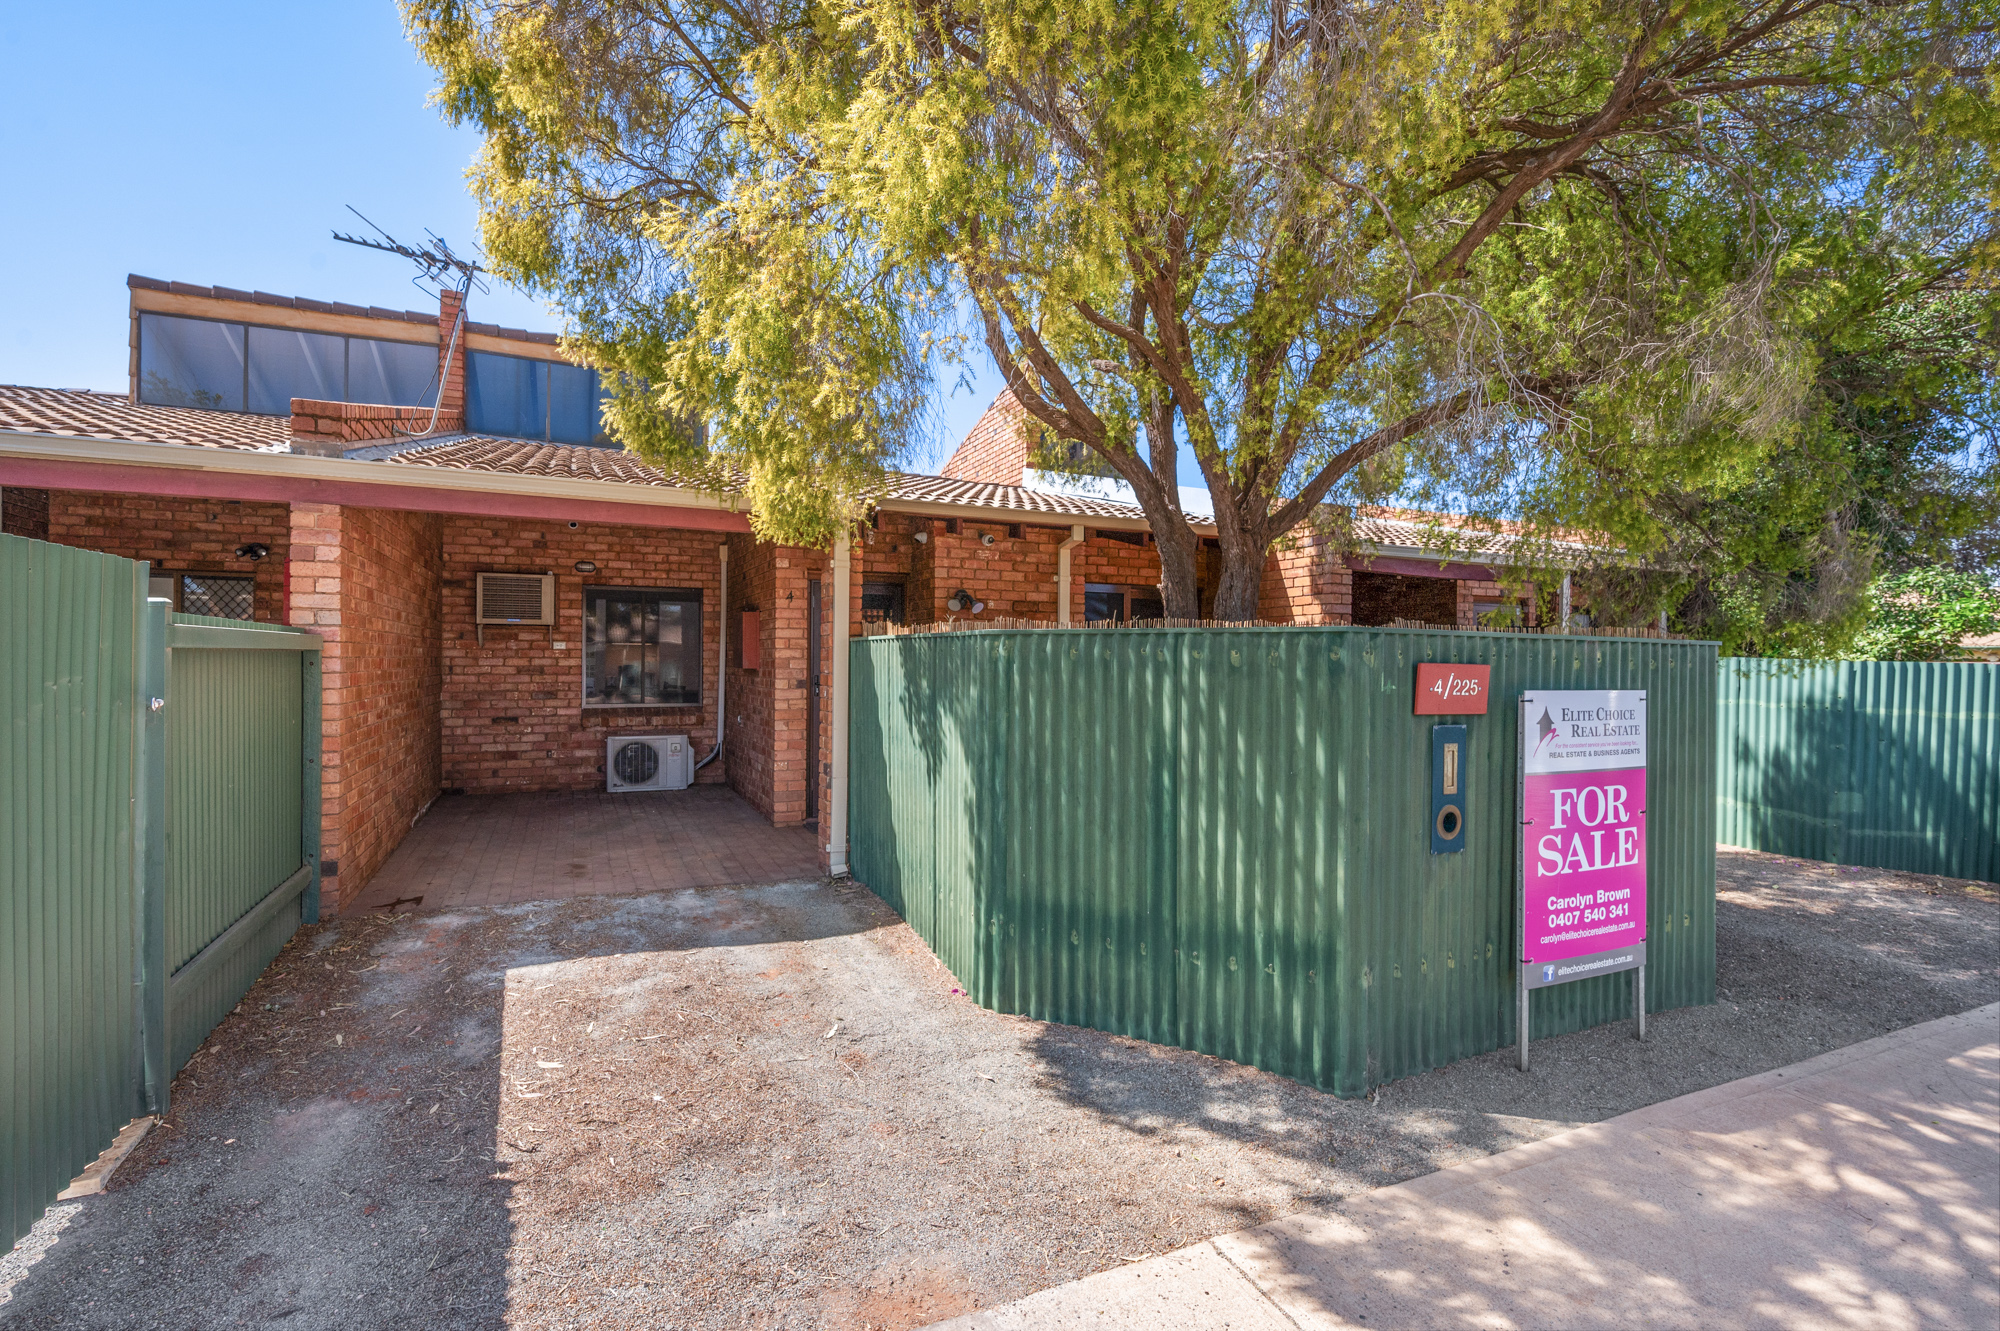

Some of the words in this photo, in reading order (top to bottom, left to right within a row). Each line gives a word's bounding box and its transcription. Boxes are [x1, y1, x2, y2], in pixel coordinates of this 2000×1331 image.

[785, 590, 794, 602] 4
[1434, 673, 1478, 699] 4/225
[1562, 708, 1594, 721] ELITE
[1596, 707, 1635, 721] CHOICE
[1571, 724, 1600, 737] REAL
[1603, 723, 1640, 736] ESTATE
[1550, 785, 1630, 829] FOR
[1538, 827, 1639, 877] SALE
[1548, 893, 1593, 910] Carolyn
[1597, 888, 1630, 903] Brown
[1549, 911, 1580, 928] 0407
[1584, 907, 1606, 922] 540
[1610, 903, 1628, 918] 341
[1540, 921, 1635, 944] carolyn@elitechoicerealestate.com.au
[1558, 955, 1633, 976] elitechoicerealestate.com.au
